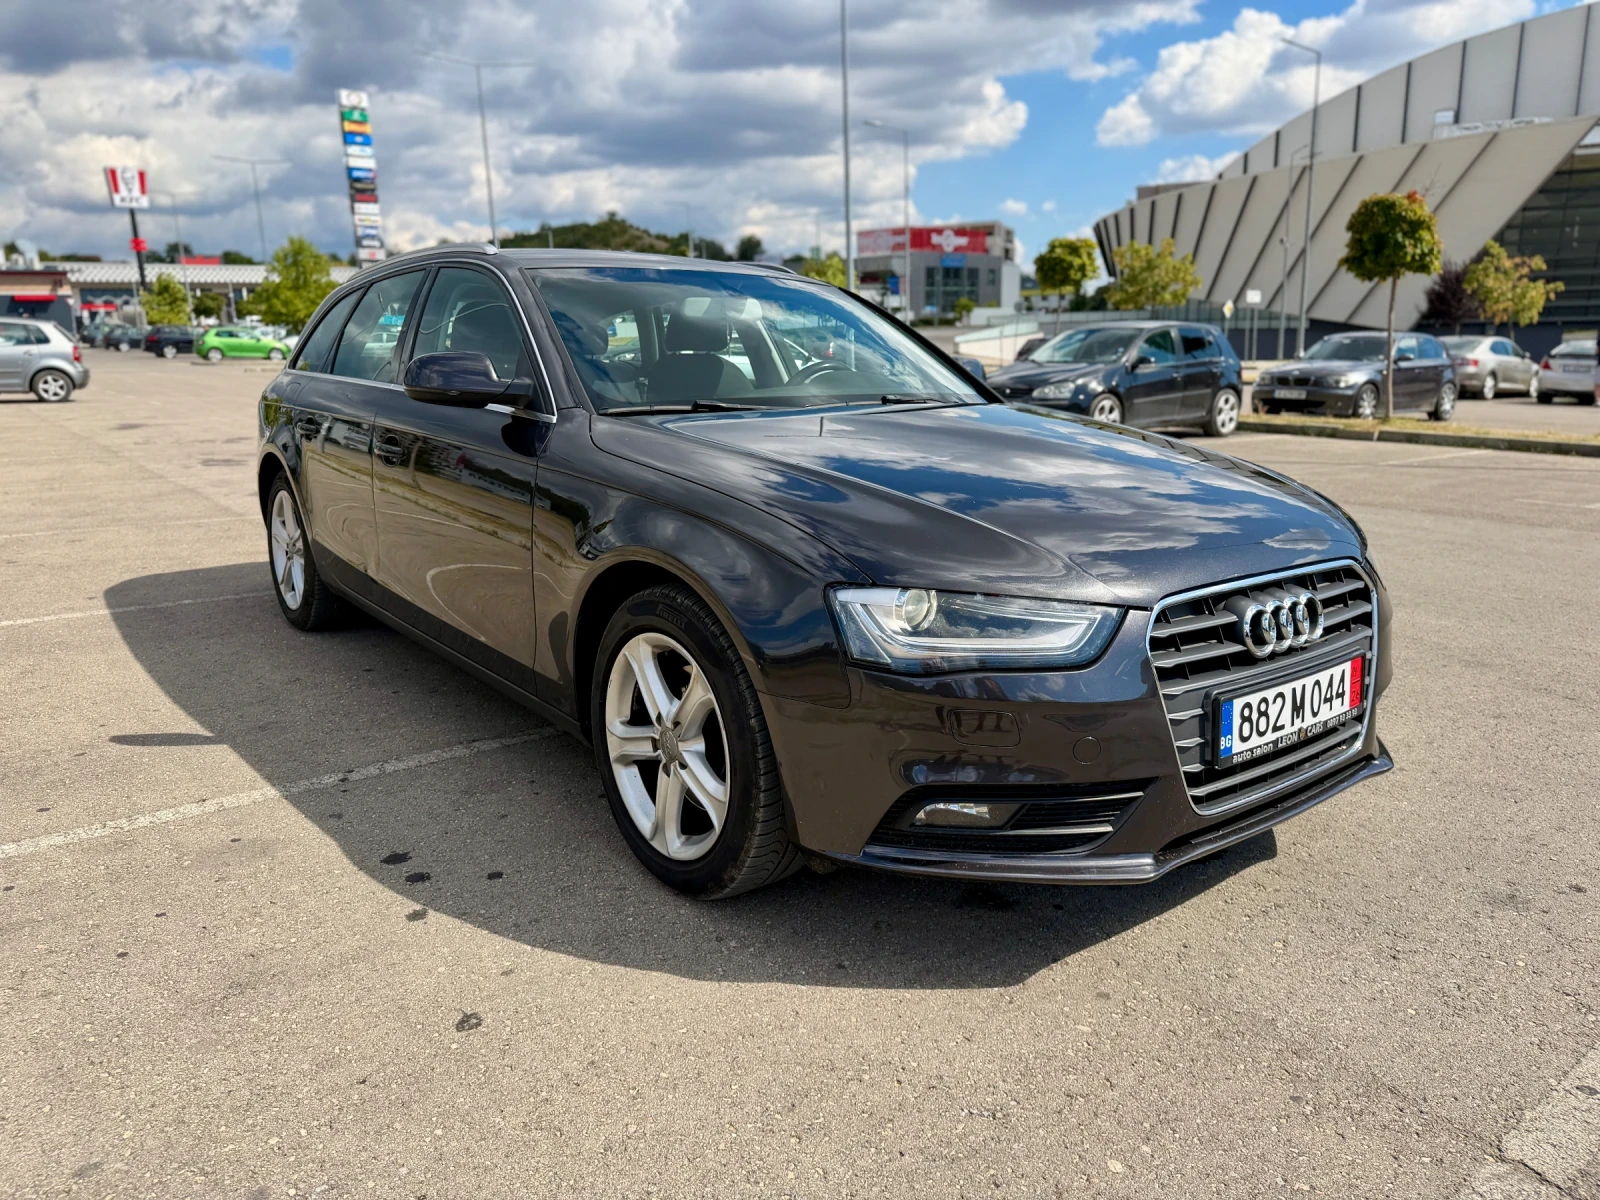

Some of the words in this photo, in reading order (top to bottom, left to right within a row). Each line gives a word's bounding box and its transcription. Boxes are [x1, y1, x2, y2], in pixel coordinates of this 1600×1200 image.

[656, 603, 688, 629] PIRELLI
[1220, 734, 1232, 749] BG
[1232, 750, 1251, 764] auto
[1252, 743, 1273, 757] salon
[1277, 731, 1299, 748] LEON
[1306, 721, 1324, 737] CARS
